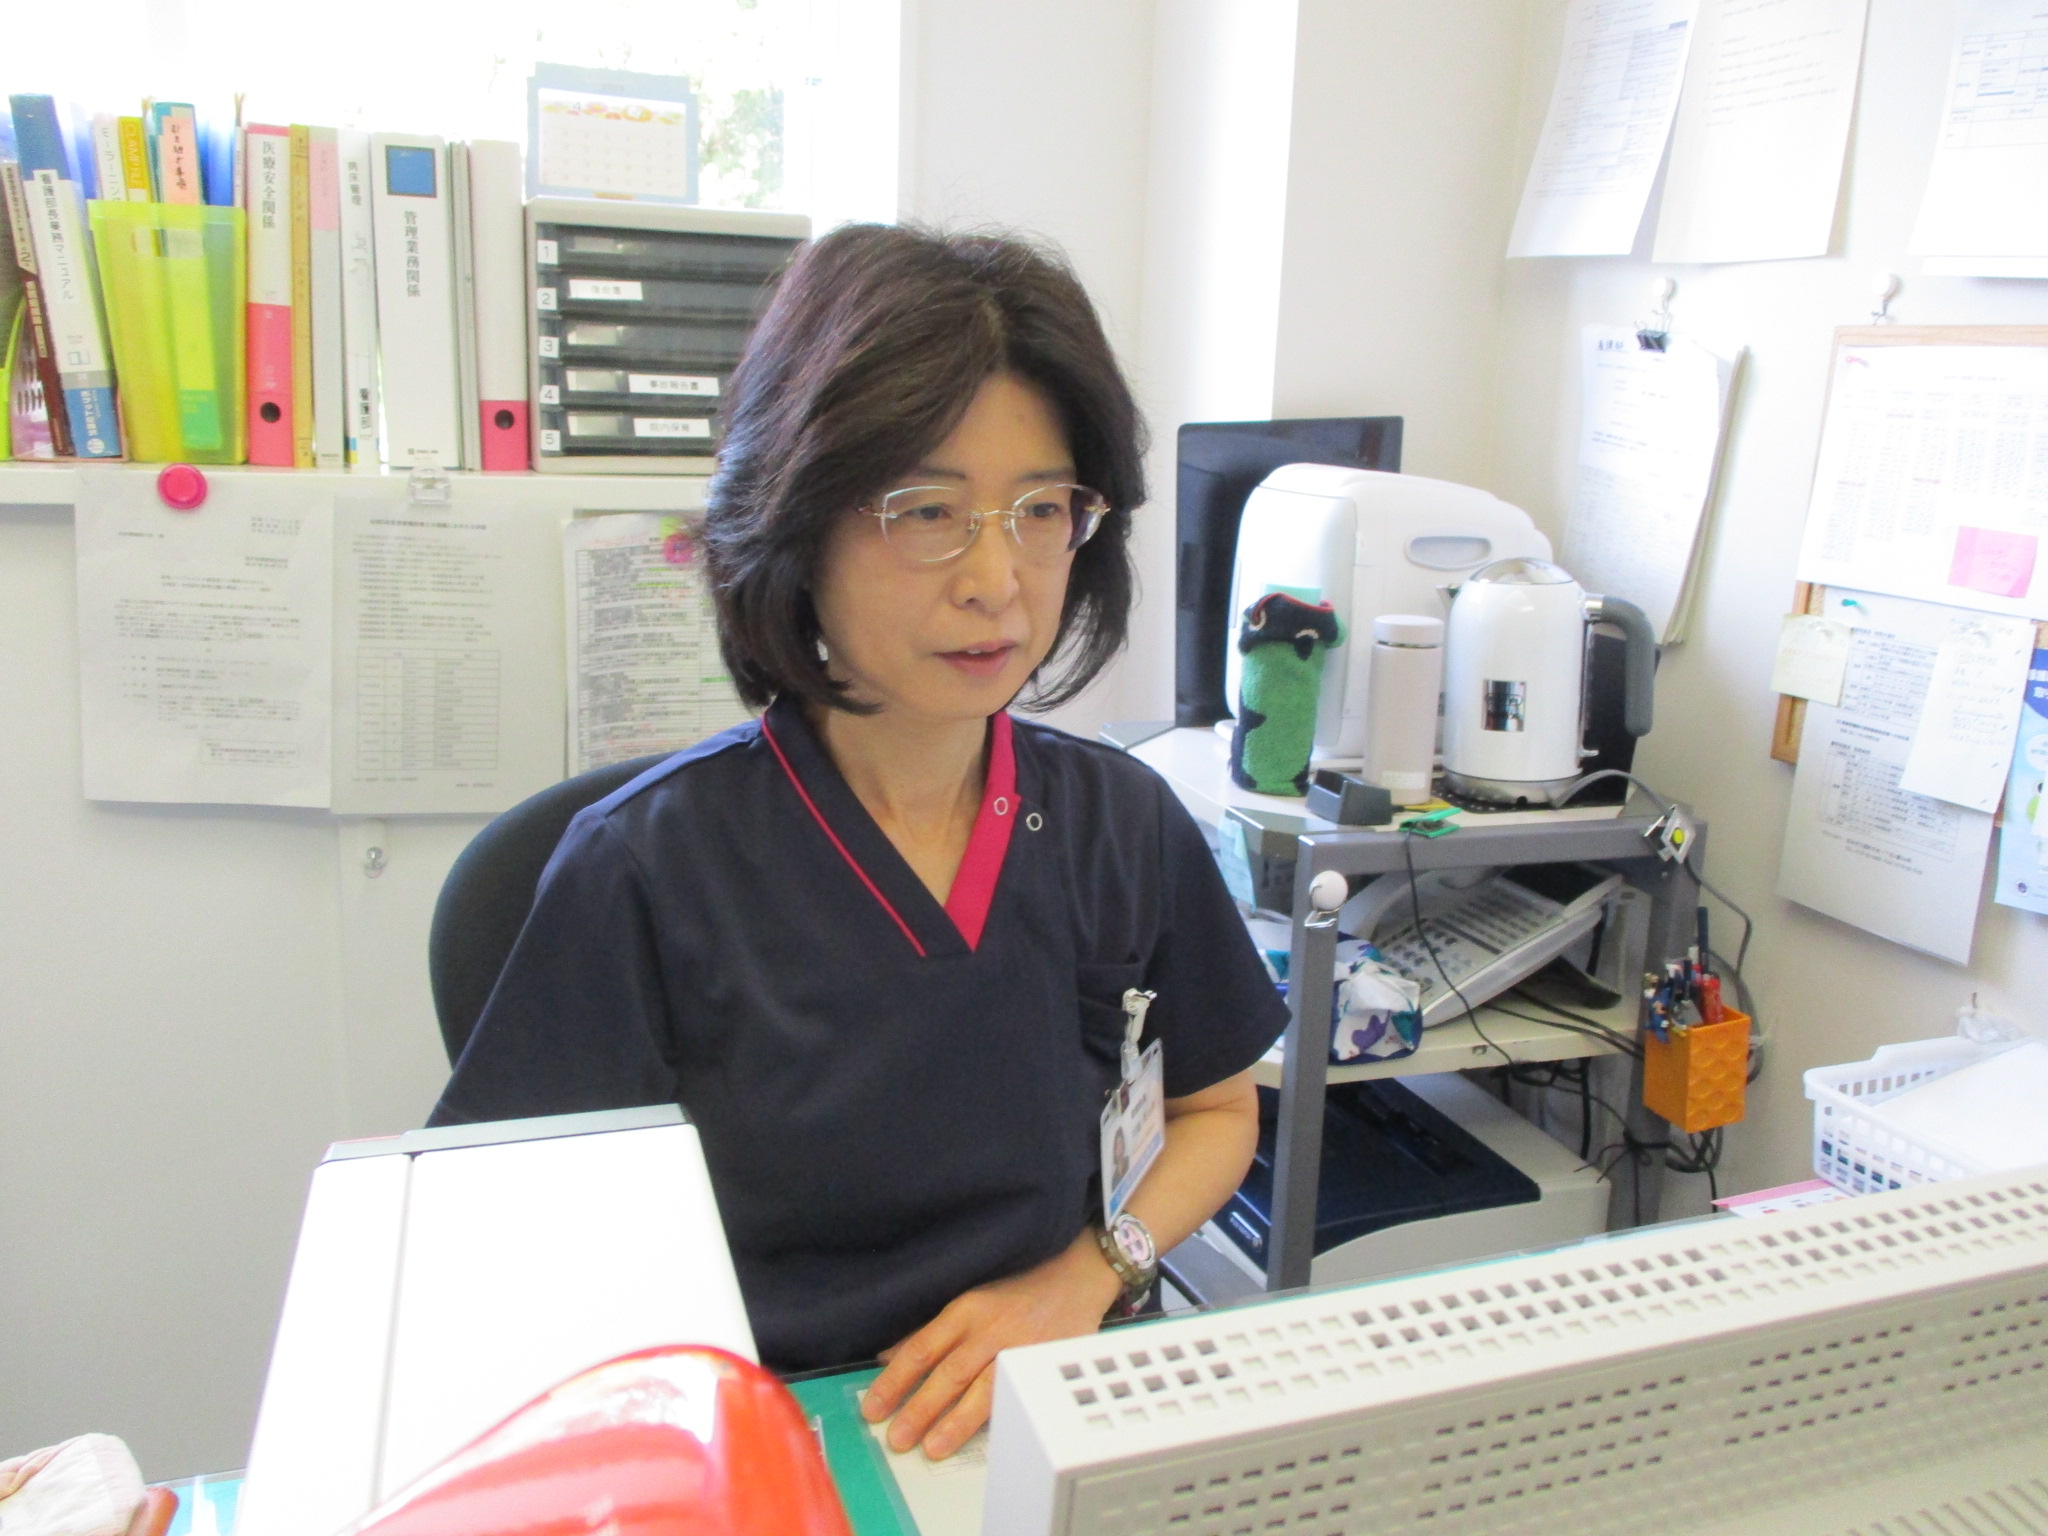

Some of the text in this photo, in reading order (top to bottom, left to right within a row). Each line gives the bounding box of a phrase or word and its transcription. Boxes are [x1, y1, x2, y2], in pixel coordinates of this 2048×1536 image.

[262, 140, 276, 230] 医療安全関係
[403, 209, 421, 298] 管理業務関係
[543, 245, 550, 257] 1
[541, 293, 551, 305] 2
[544, 340, 553, 352] 3
[649, 379, 700, 391] 事故報告書
[543, 388, 553, 400] 4
[546, 433, 555, 445] 5
